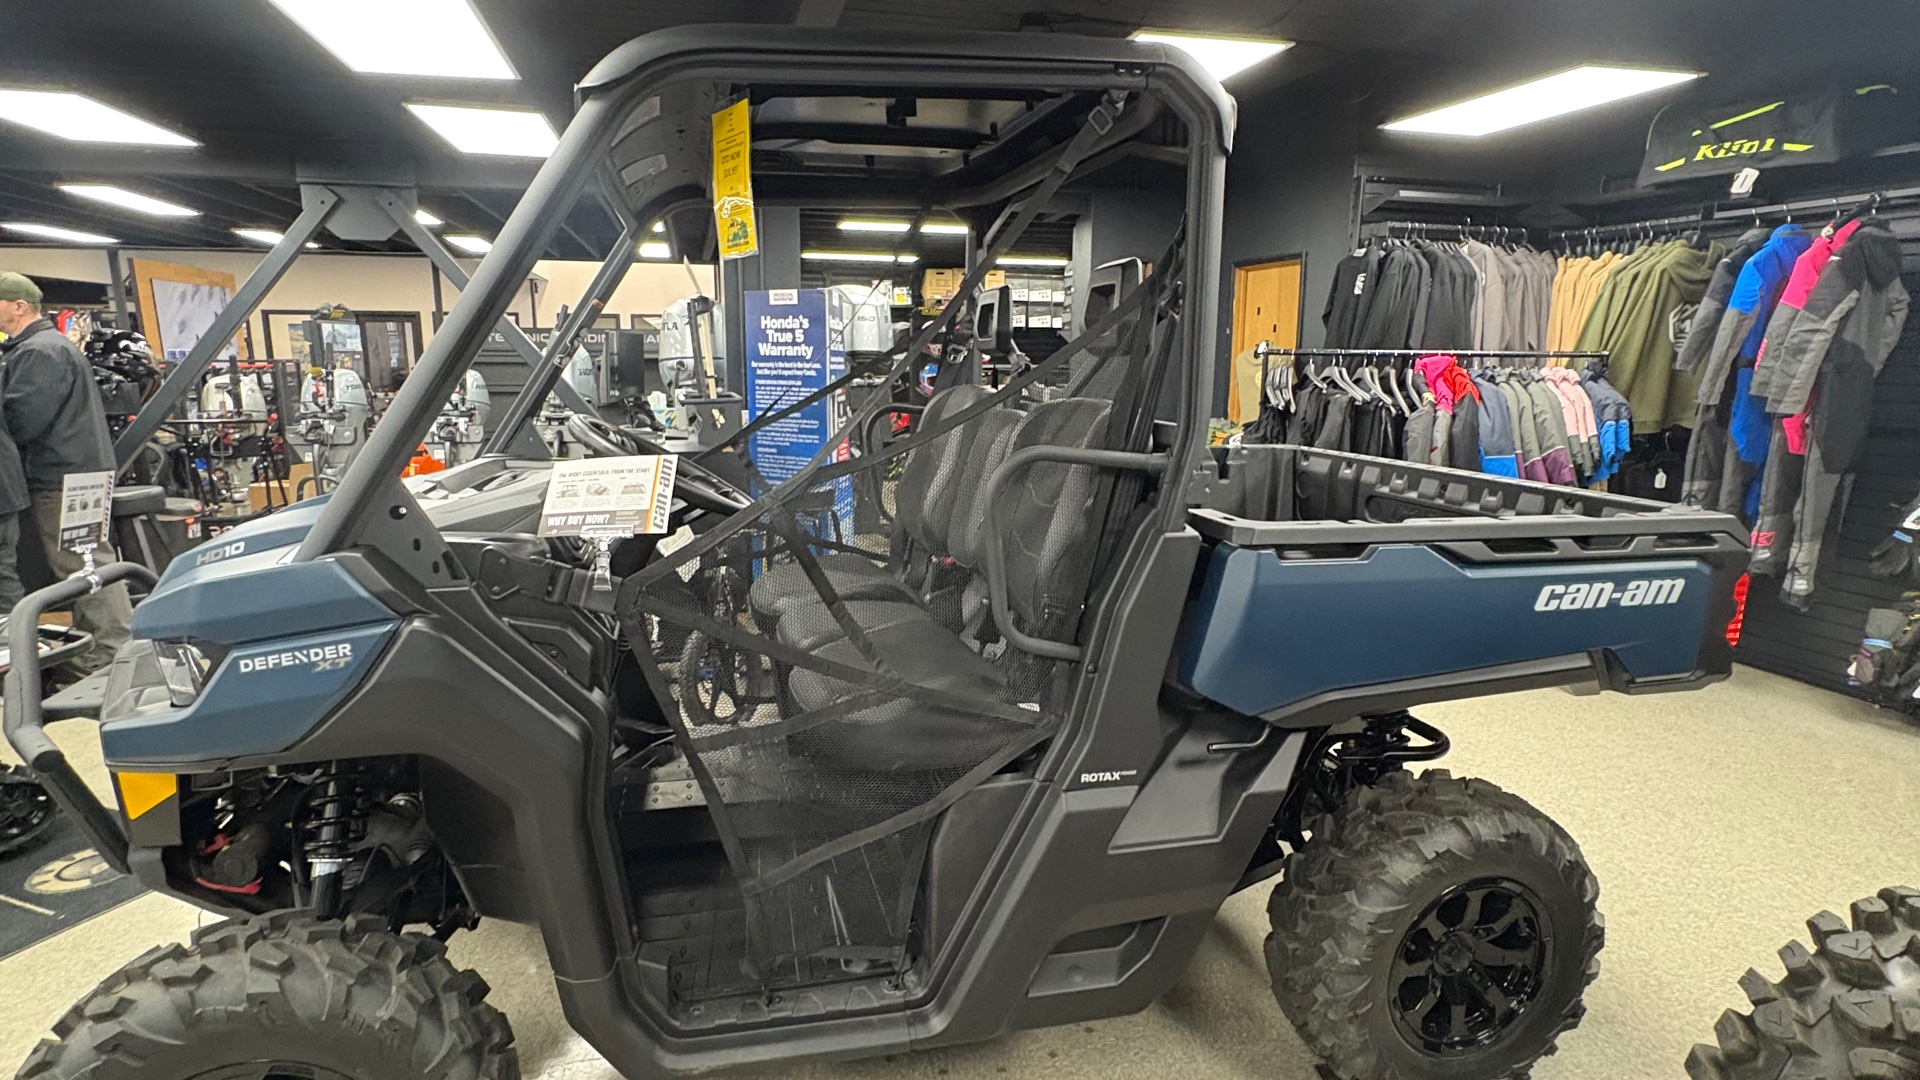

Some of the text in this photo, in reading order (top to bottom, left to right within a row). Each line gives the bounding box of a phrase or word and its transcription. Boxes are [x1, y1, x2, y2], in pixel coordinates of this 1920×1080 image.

[760, 315, 810, 329] Honda's
[766, 329, 805, 343] True 5
[758, 342, 814, 360] Warranty
[652, 458, 674, 530] can-am
[547, 514, 567, 527] WHY
[566, 514, 584, 526] BUY
[585, 513, 611, 525] NOW?
[195, 541, 245, 566] HD10
[1533, 577, 1686, 612] can-am
[238, 643, 352, 673] DEFENDER
[311, 657, 352, 673] XT
[1080, 771, 1121, 783] ROTAX
